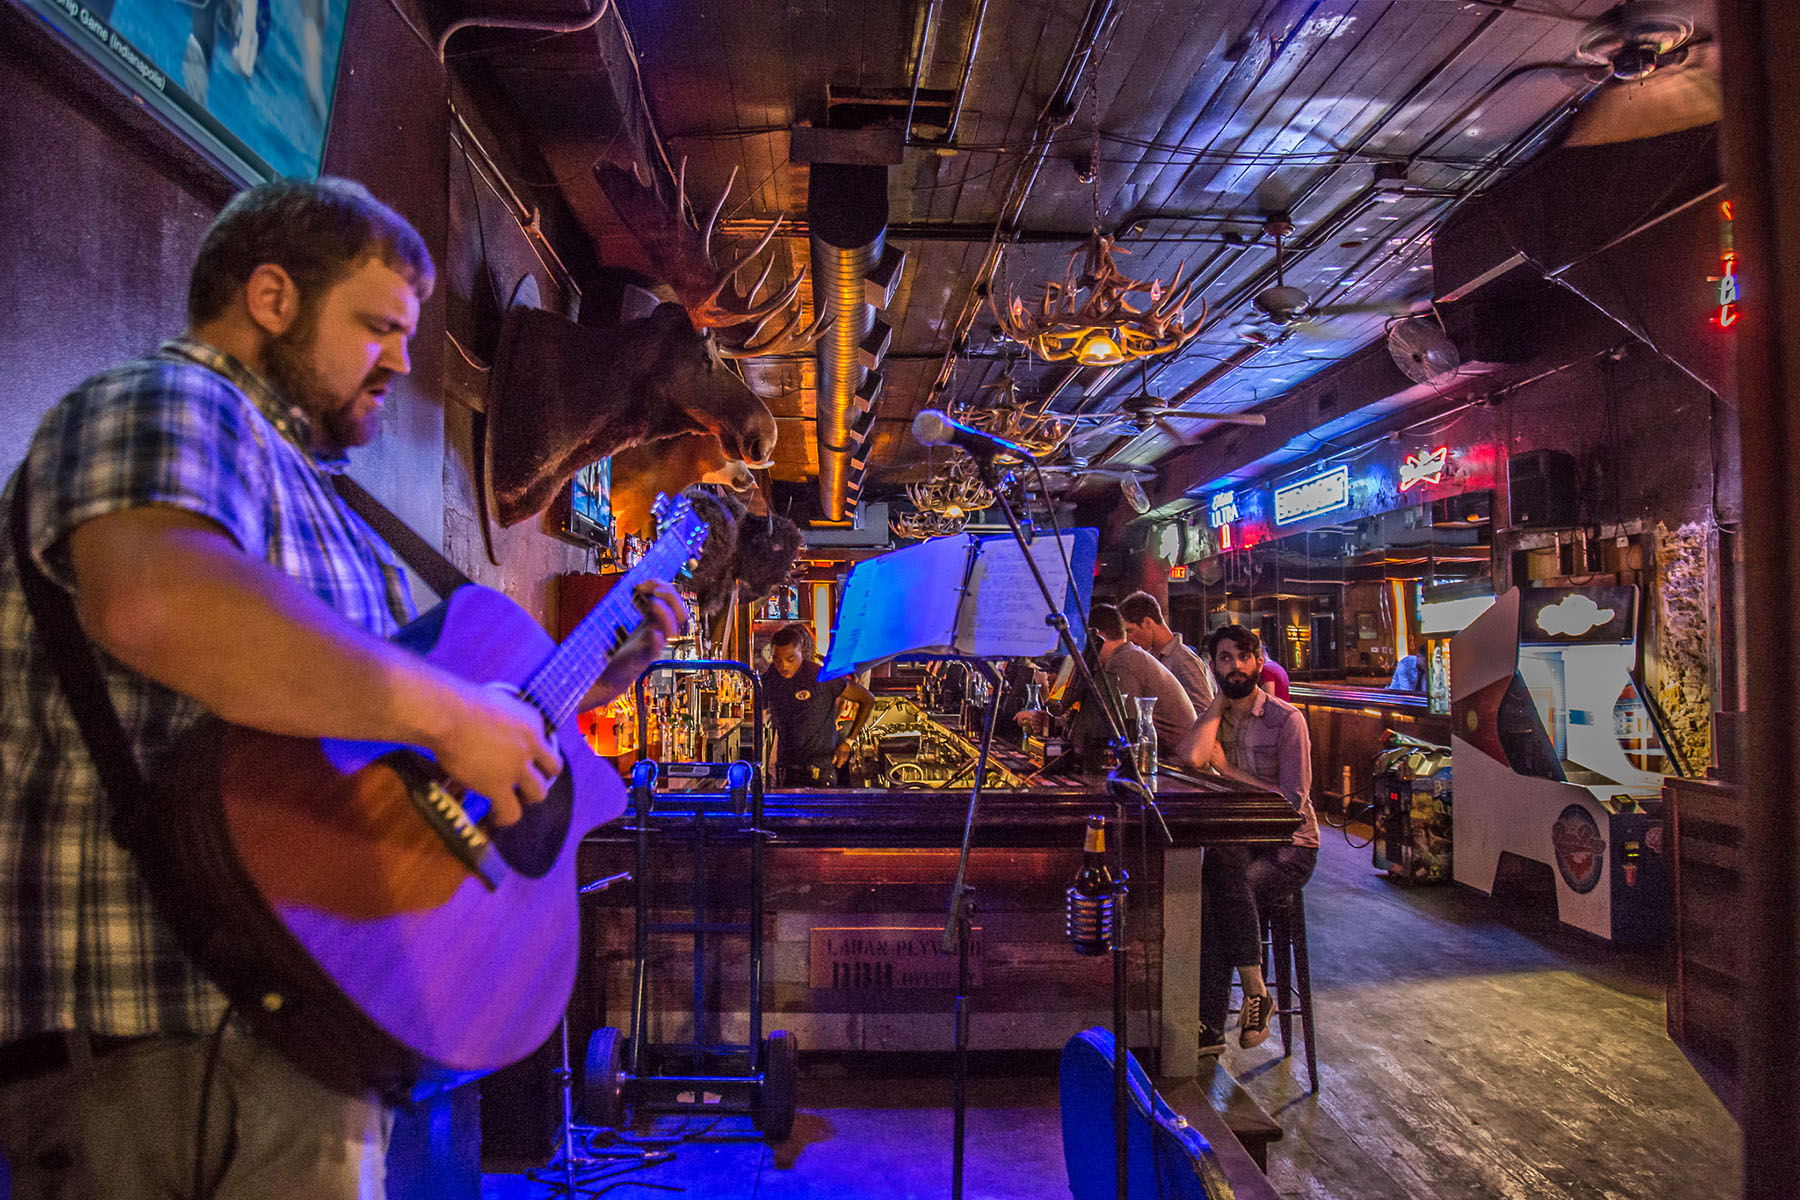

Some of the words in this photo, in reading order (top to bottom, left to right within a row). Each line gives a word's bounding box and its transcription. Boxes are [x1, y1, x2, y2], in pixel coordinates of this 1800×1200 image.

[80, 9, 109, 41] Game
[110, 33, 166, 92] (Indianapolis)
[1211, 503, 1239, 528] ULTRA
